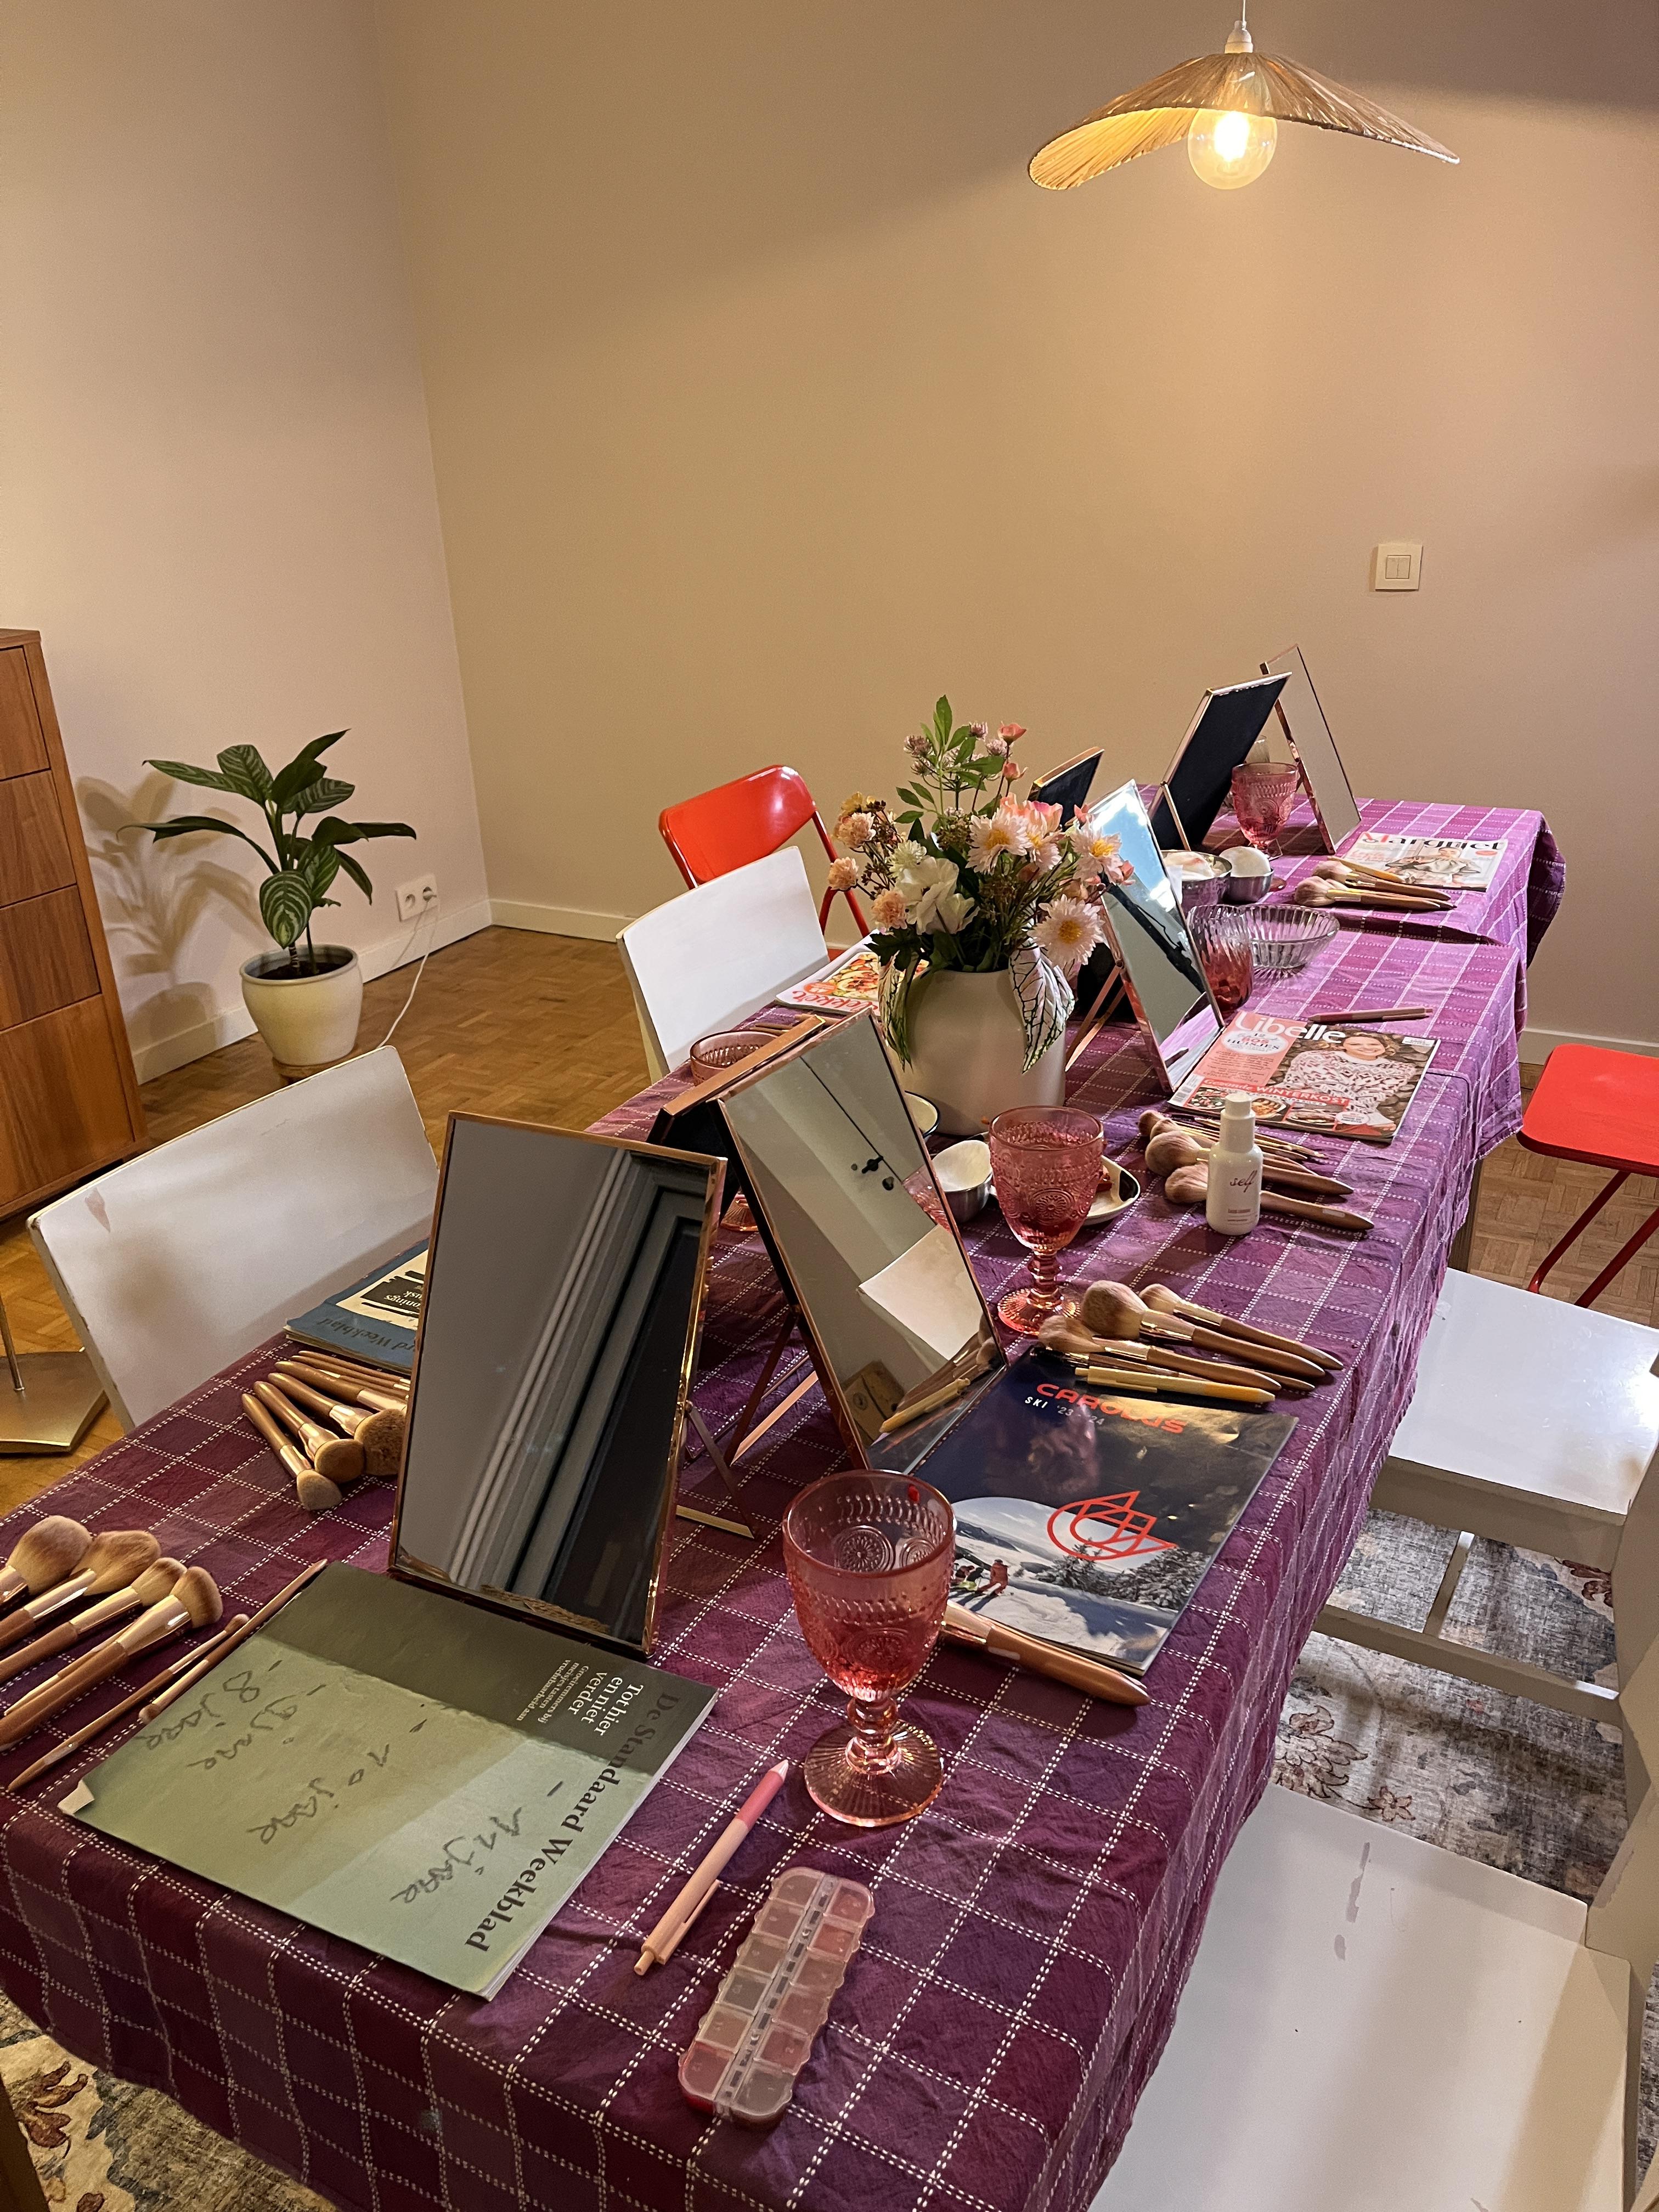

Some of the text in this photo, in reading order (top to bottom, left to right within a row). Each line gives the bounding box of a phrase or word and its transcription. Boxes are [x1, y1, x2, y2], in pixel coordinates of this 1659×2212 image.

[1235, 1011, 1346, 1043] Libelle
[1256, 1086, 1348, 1104] WINTERKOST
[1230, 1170, 1257, 1193] self
[384, 1294, 421, 1310] onings
[403, 1290, 422, 1300] usk
[317, 1318, 392, 1347] Weekblad
[1024, 1396, 1048, 1408] SKI
[1036, 1384, 1187, 1434] CAROLUS
[222, 1669, 260, 1703] 8
[538, 1666, 589, 1724] Groeiremmers bij
[539, 1662, 580, 1709] meisjes tasten
[568, 1672, 607, 1715] verder
[580, 1676, 623, 1724] en niet
[594, 1684, 644, 1736] Tot hier
[464, 1692, 681, 1952] De Standaard Weekblad
